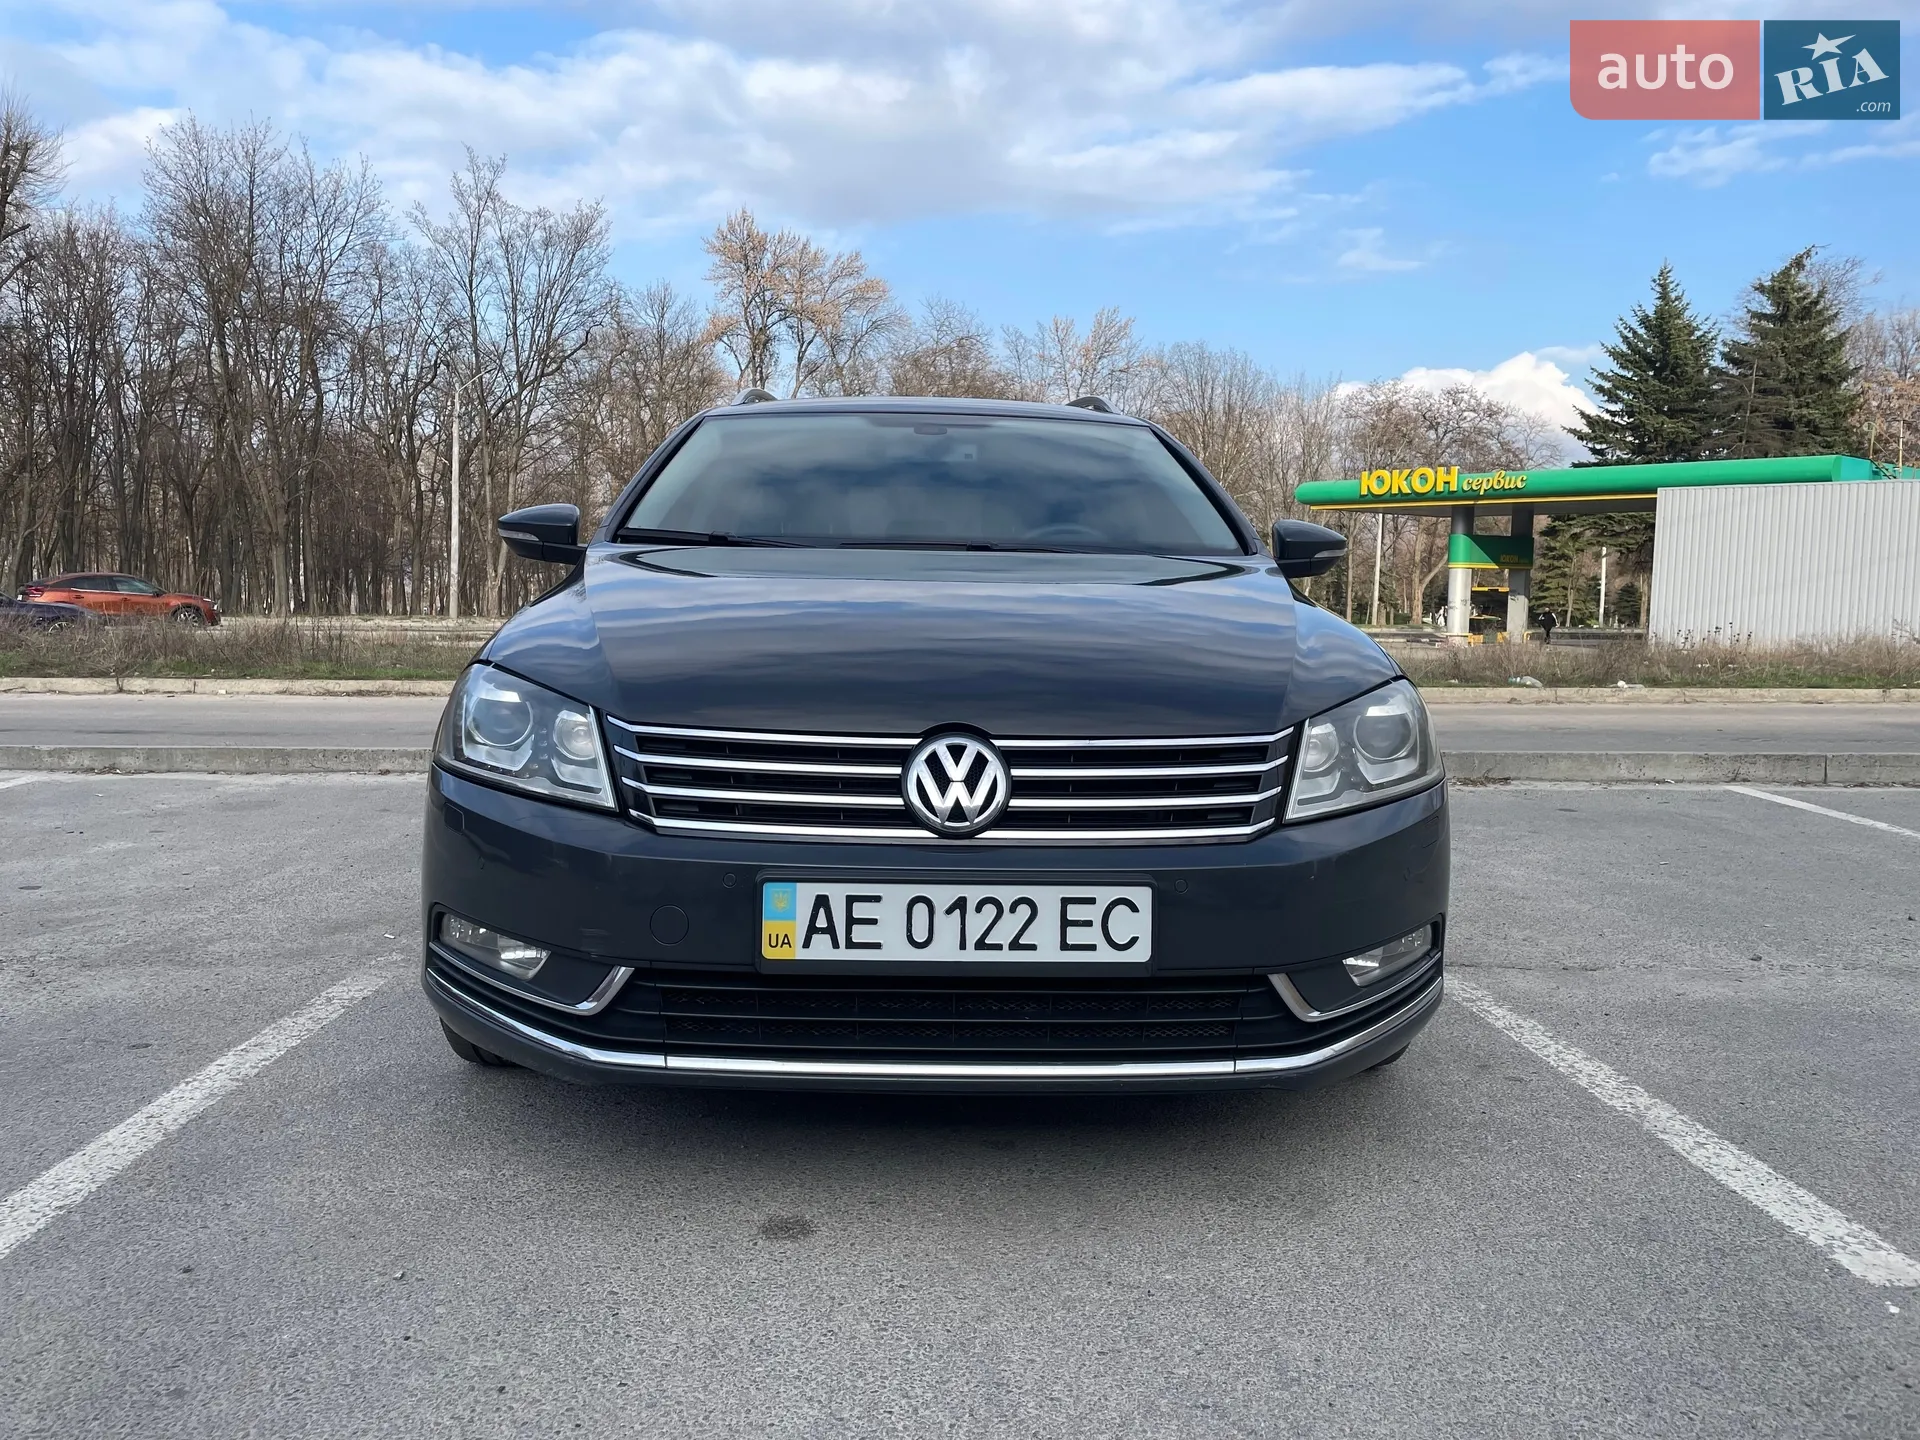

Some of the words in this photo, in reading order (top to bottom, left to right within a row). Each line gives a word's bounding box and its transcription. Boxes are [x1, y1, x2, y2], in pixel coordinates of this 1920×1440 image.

[1361, 466, 1459, 496] ЮКОН
[1462, 470, 1527, 495] сервис
[802, 894, 883, 950] AE
[905, 895, 1038, 951] 0122
[1060, 897, 1140, 952] EC
[768, 933, 792, 949] UA
